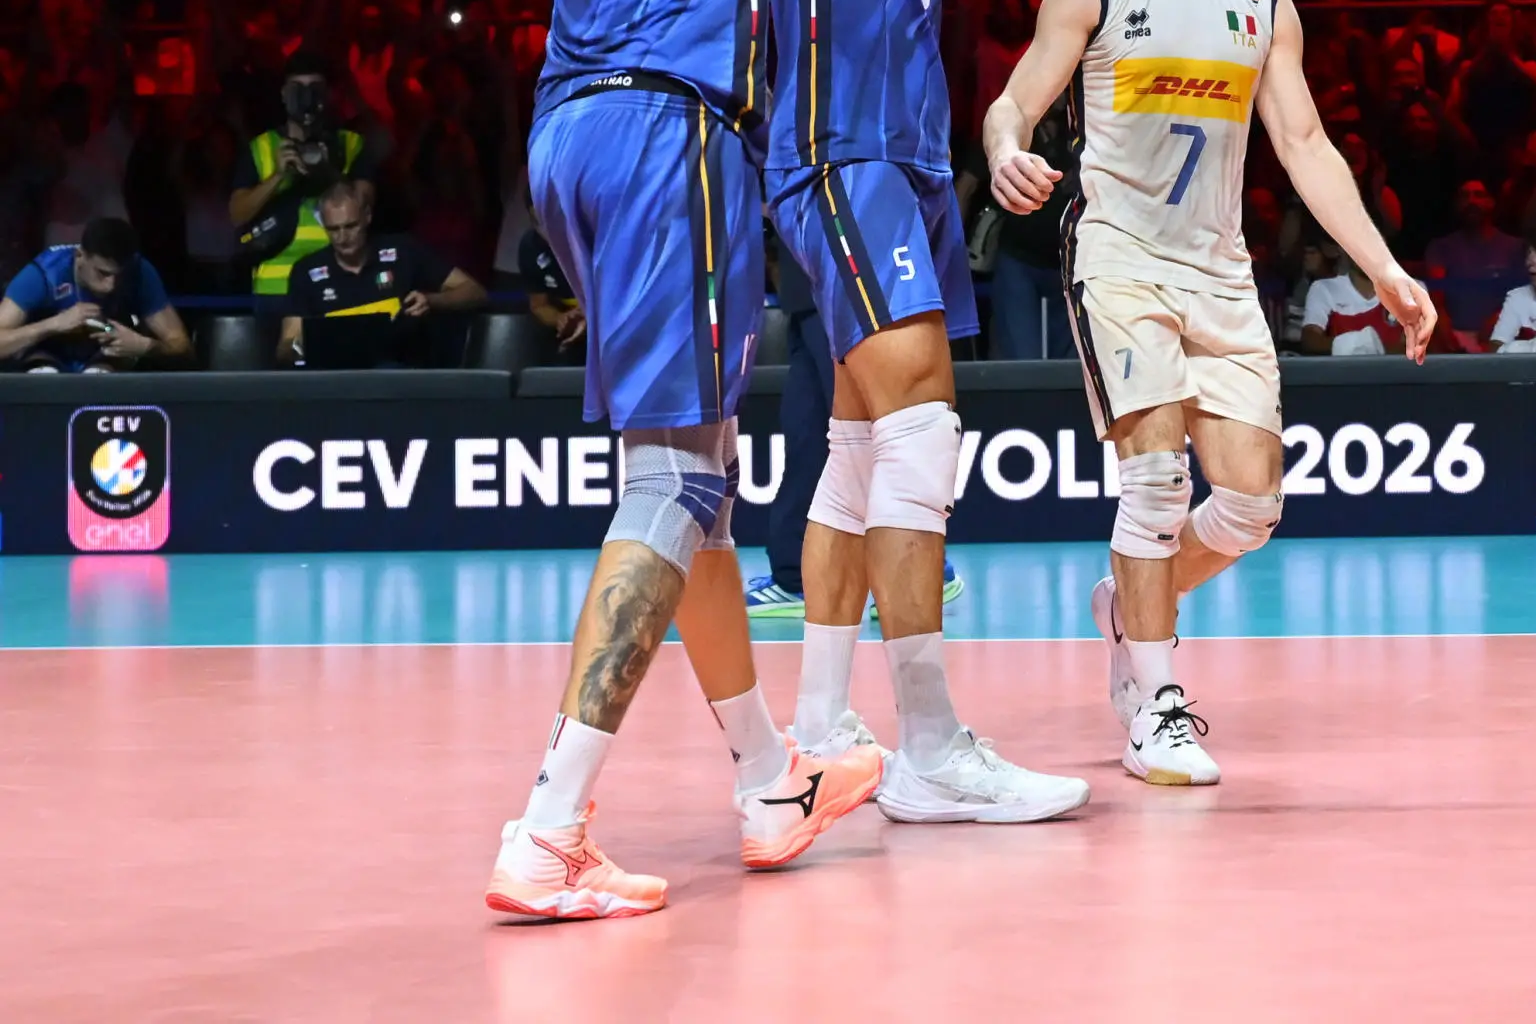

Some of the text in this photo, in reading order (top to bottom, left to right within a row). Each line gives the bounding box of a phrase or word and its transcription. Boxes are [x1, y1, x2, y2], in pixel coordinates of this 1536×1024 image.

[1232, 32, 1257, 49] ITA
[1149, 75, 1233, 101] DHL
[1165, 122, 1207, 205] 7
[893, 246, 915, 280] 5
[1114, 347, 1133, 380] 7
[97, 415, 141, 433] CEV
[253, 439, 428, 511] CEV
[455, 436, 625, 508] ENE
[1281, 422, 1486, 495] 2026
[85, 519, 151, 544] enel
